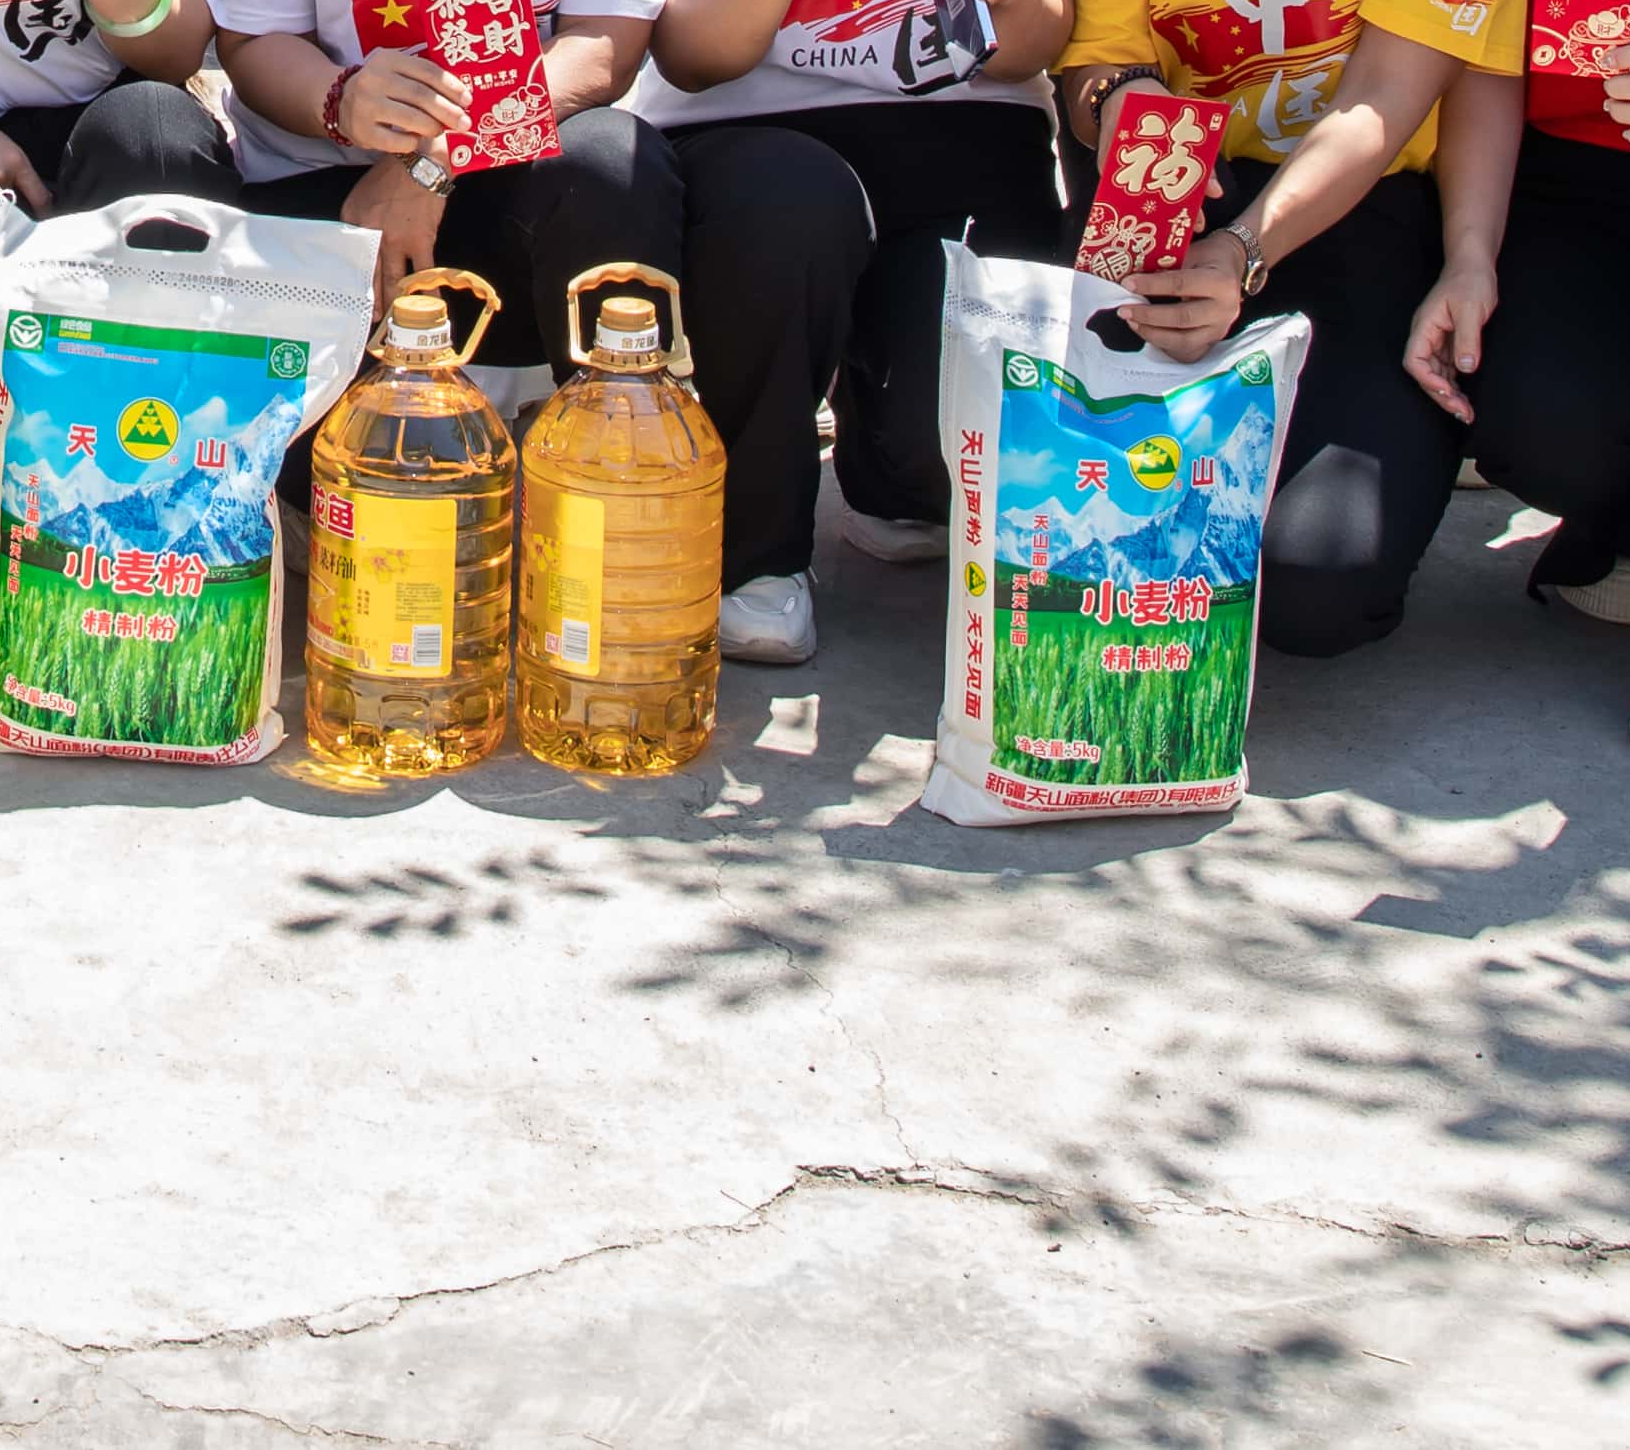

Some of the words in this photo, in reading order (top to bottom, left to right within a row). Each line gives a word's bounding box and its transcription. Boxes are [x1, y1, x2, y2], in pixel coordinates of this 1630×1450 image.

[433, 11, 531, 67] 發財
[791, 44, 881, 69] CHINA
[1112, 104, 1206, 204] 福
[621, 336, 656, 349] 金龙鱼
[66, 423, 100, 459] 天
[195, 436, 228, 470] 山
[1077, 458, 1109, 491] 天
[1190, 455, 1216, 487] 山
[24, 473, 40, 542] 天山面粉
[960, 428, 984, 547] 天山面粉
[7, 524, 23, 594] 天天见面
[63, 547, 210, 600] 小麦粉
[1030, 514, 1050, 586] 天山面粉
[82, 607, 178, 644] 精制粉
[1010, 573, 1029, 647] 天天见面
[1081, 578, 1213, 626] 小麦粉
[964, 608, 985, 721] 天天见面
[1101, 642, 1191, 672] 精制粉
